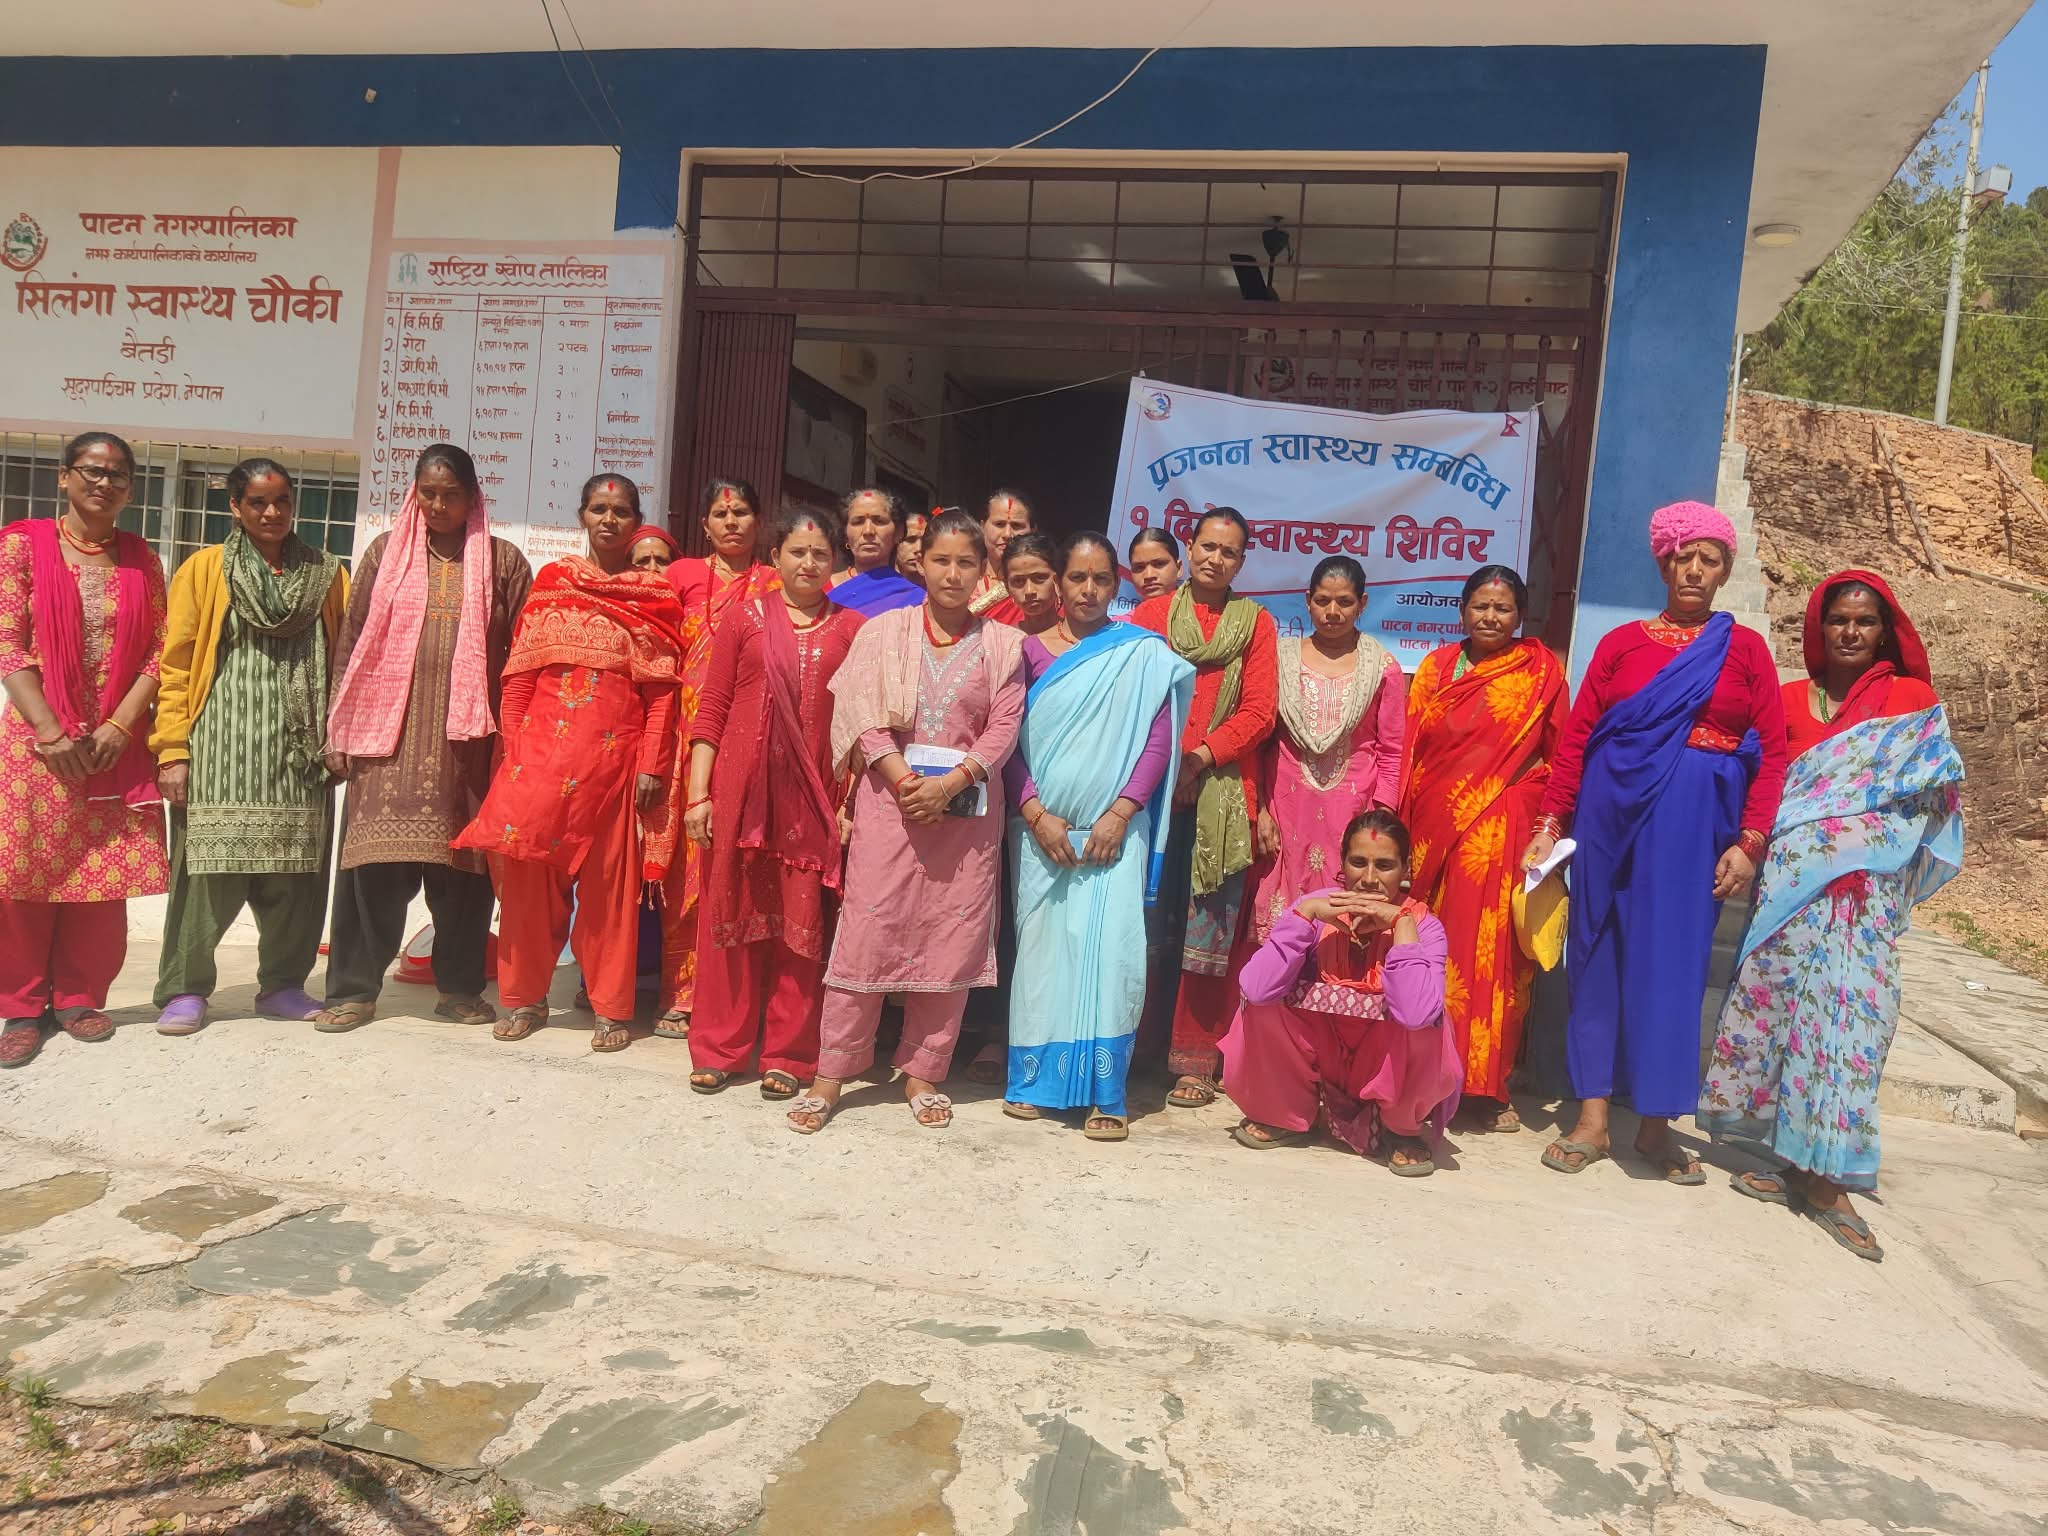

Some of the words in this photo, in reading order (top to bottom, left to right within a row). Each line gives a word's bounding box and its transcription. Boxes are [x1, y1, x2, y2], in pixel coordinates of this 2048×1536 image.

[79, 213, 146, 235] पाटन
[153, 205, 298, 239] नगरपालिका
[203, 242, 258, 263] कार्यालय
[538, 256, 609, 281] तालिका
[15, 270, 116, 320] सिलंगा
[126, 284, 237, 322] स्वास्थ्य
[246, 274, 343, 323] चौकी
[120, 328, 176, 364] बैतडी
[403, 332, 426, 352] रोटा
[183, 373, 225, 401] नेपाल
[1147, 438, 1254, 492] प्रजनन
[1262, 434, 1382, 467] स्वास्थ्य
[1391, 443, 1511, 512] सम्बन्धि
[1130, 505, 1149, 531] १
[1385, 514, 1495, 563] शिविर
[1381, 619, 1412, 632] पाटन
